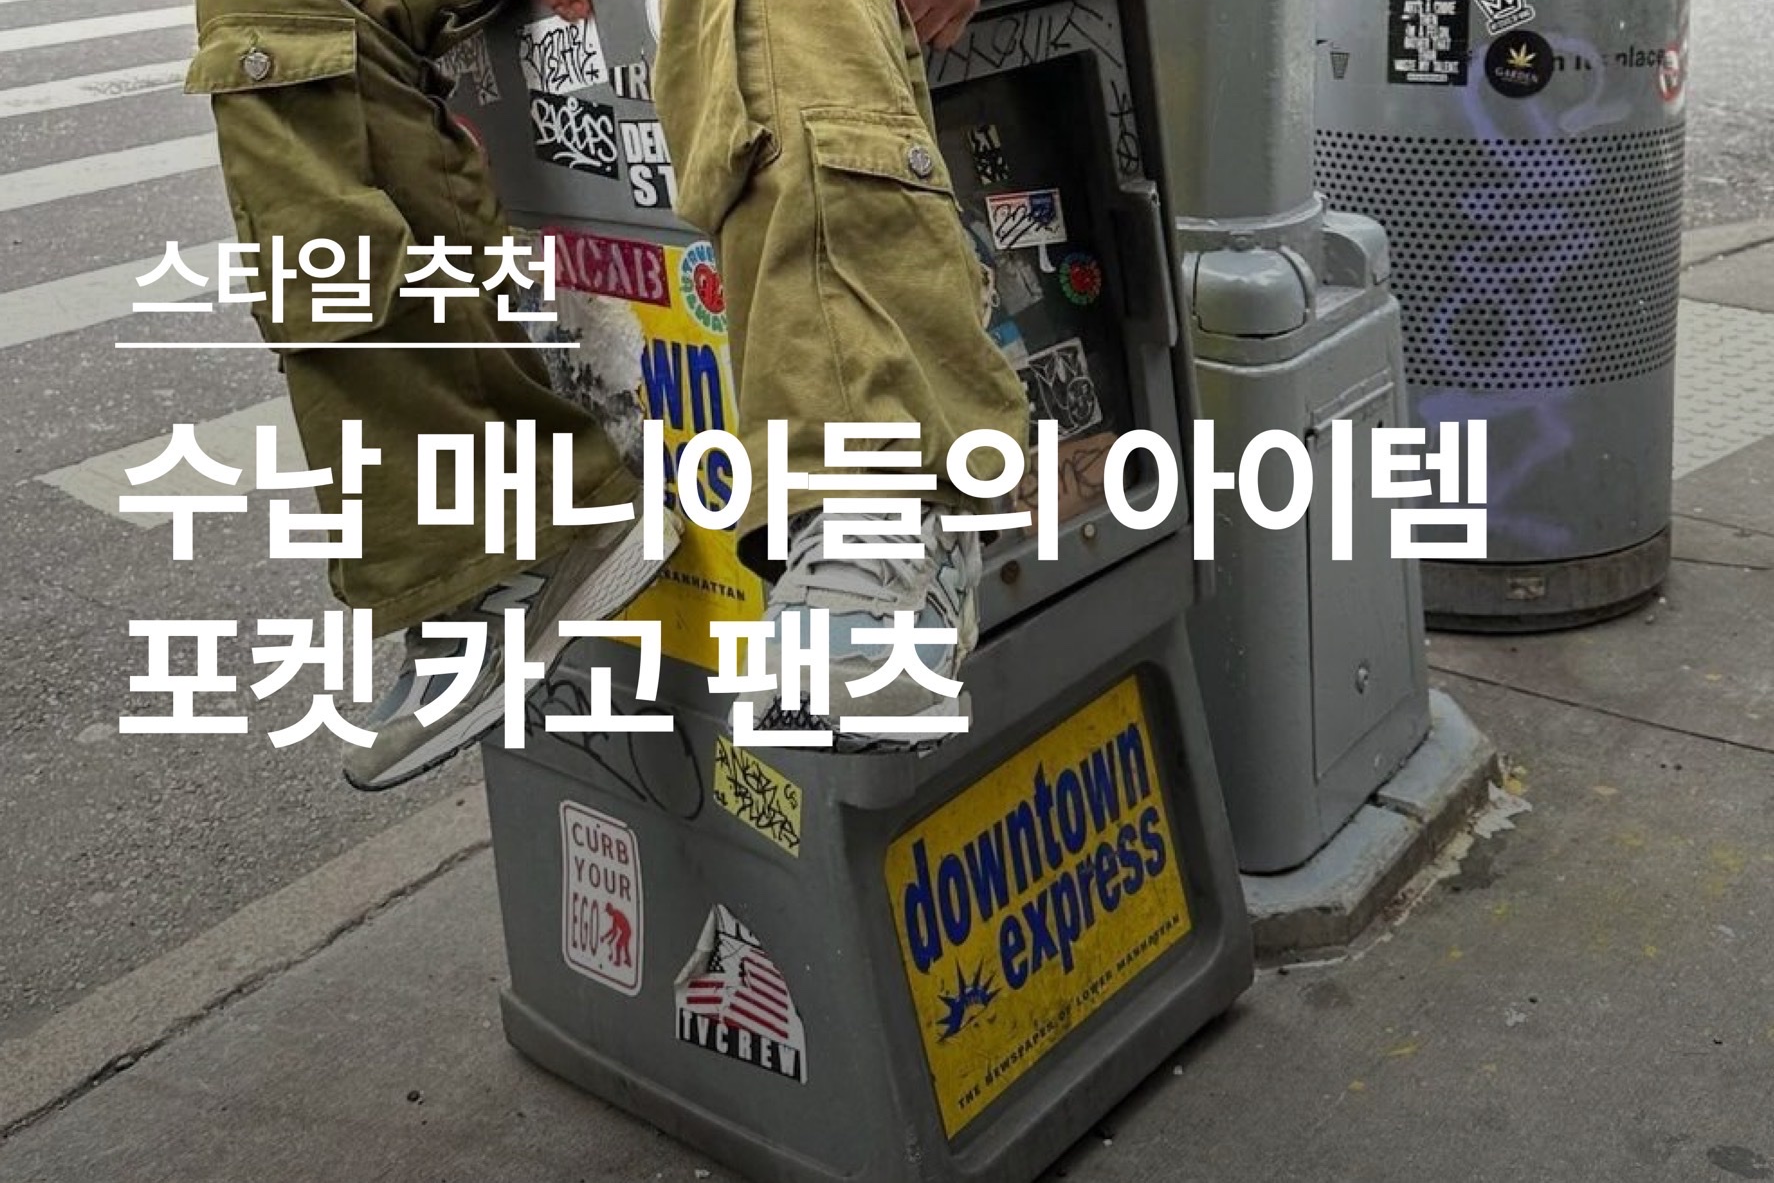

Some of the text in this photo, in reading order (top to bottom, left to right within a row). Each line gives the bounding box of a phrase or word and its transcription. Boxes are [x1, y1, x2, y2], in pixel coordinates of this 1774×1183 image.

[572, 821, 629, 865] CURB
[574, 855, 631, 902] YOUR
[904, 722, 1151, 975] downtown
[572, 891, 600, 957] EGO
[999, 805, 1167, 989] express
[957, 1086, 982, 1110] THE
[1075, 969, 1113, 1007] LOWER
